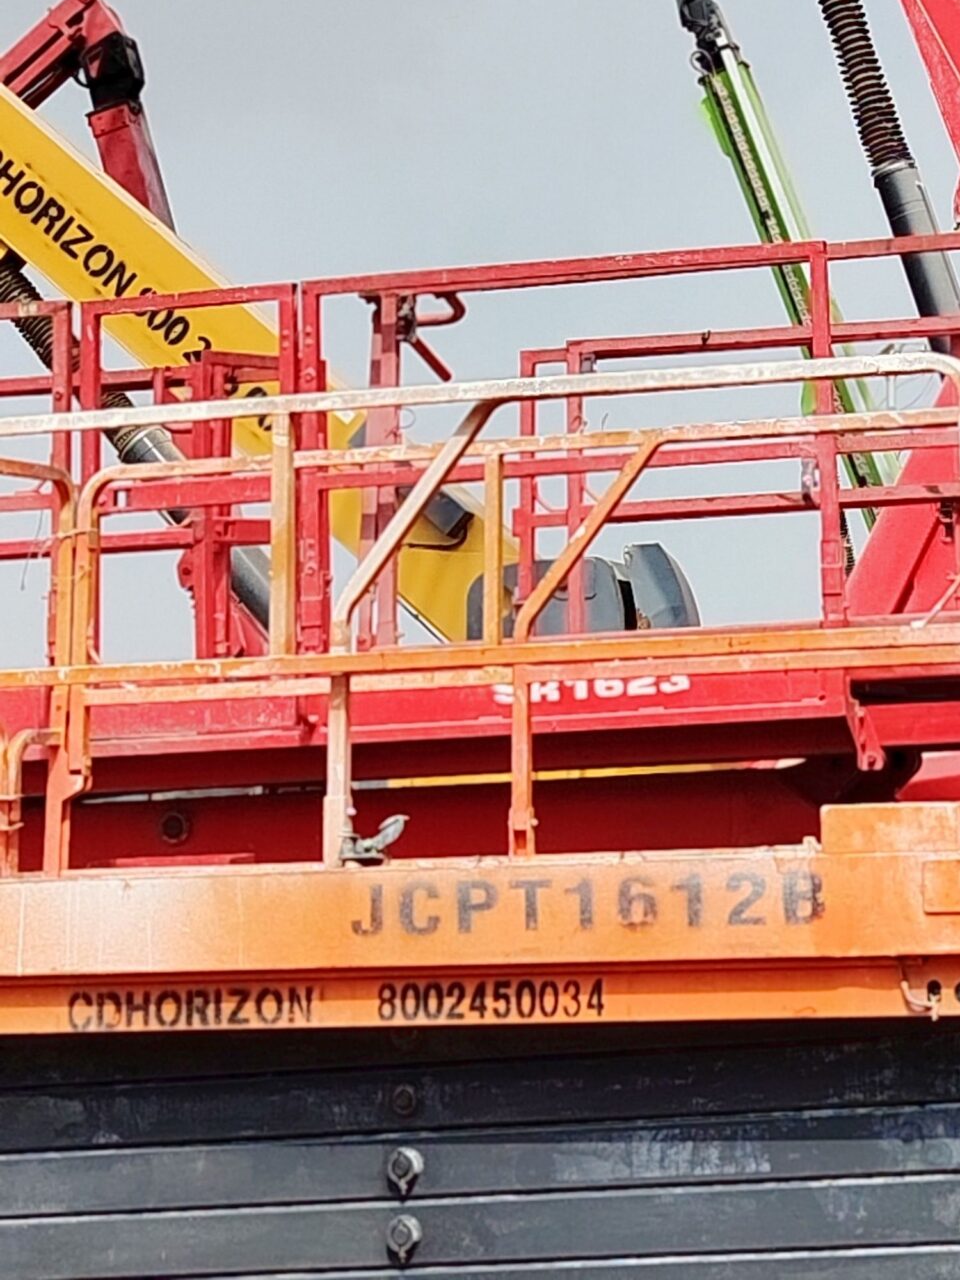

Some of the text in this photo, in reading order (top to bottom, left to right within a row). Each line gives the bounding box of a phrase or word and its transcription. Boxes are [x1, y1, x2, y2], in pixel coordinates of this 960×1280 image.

[0, 149, 137, 297] HORIZON
[68, 977, 605, 1031] CDHORIZON 8002450034
